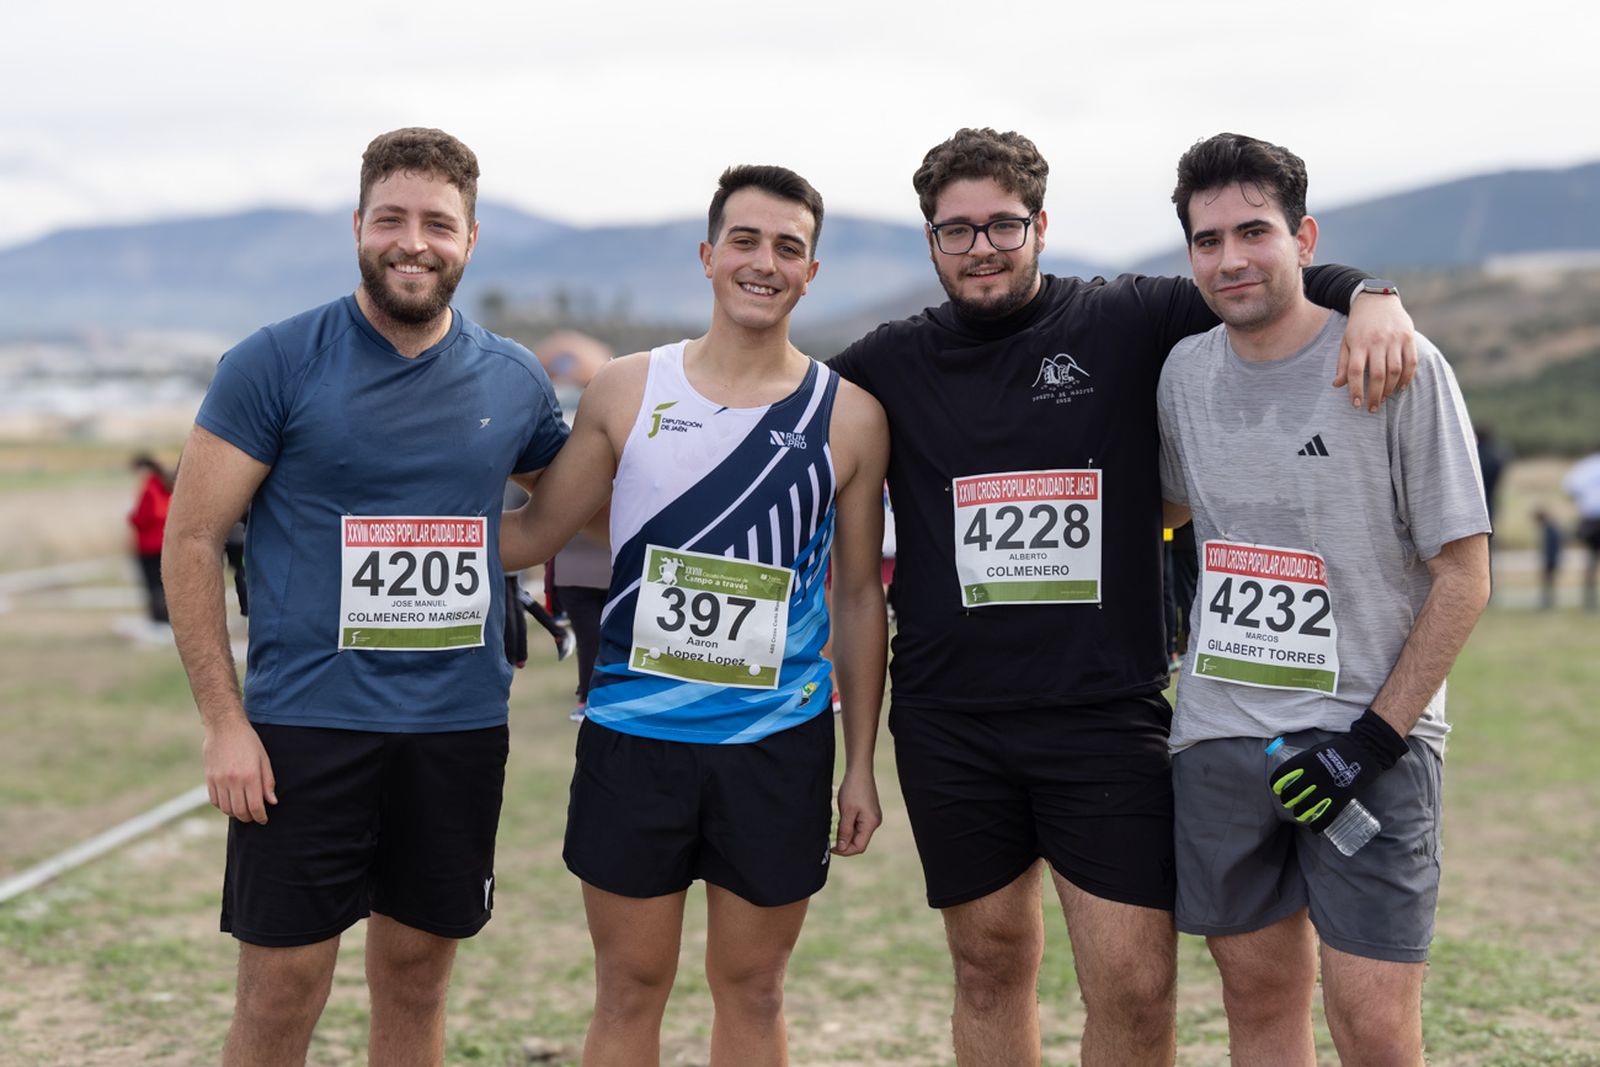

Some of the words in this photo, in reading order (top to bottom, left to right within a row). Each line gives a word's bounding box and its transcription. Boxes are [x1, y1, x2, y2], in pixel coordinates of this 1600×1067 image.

[786, 433, 806, 442] RUN
[787, 440, 807, 449] PRO
[977, 481, 1001, 500] CROSS
[1001, 478, 1036, 498] POPULAR
[1037, 477, 1064, 497] CIUDAD
[1065, 477, 1075, 496] DE
[369, 523, 396, 543] CROSS
[396, 523, 430, 543] POPULAR
[430, 523, 456, 543] CIUDAD
[456, 523, 465, 543] DE
[963, 503, 1090, 552] 4228
[1009, 553, 1048, 561] ALBERTO
[1226, 549, 1248, 571] CROSS
[1248, 552, 1279, 575] POPULAR
[1279, 556, 1307, 578] CIUDAD
[1307, 559, 1318, 579] DE
[351, 550, 480, 597] 4205
[986, 565, 1070, 578] COLMENERO
[684, 574, 714, 587] Campo
[391, 600, 413, 608] JOSE
[1209, 576, 1331, 638] 4232
[347, 612, 426, 623] COLMENERO
[428, 611, 482, 622] MARISCAL
[656, 586, 756, 642] 397
[686, 636, 719, 649] Aaron
[1245, 631, 1279, 643] MARCOS
[667, 646, 704, 662] Lopez
[708, 652, 746, 667] Lopez
[1207, 639, 1264, 658] GILABERT
[1268, 649, 1326, 665] TORRES
